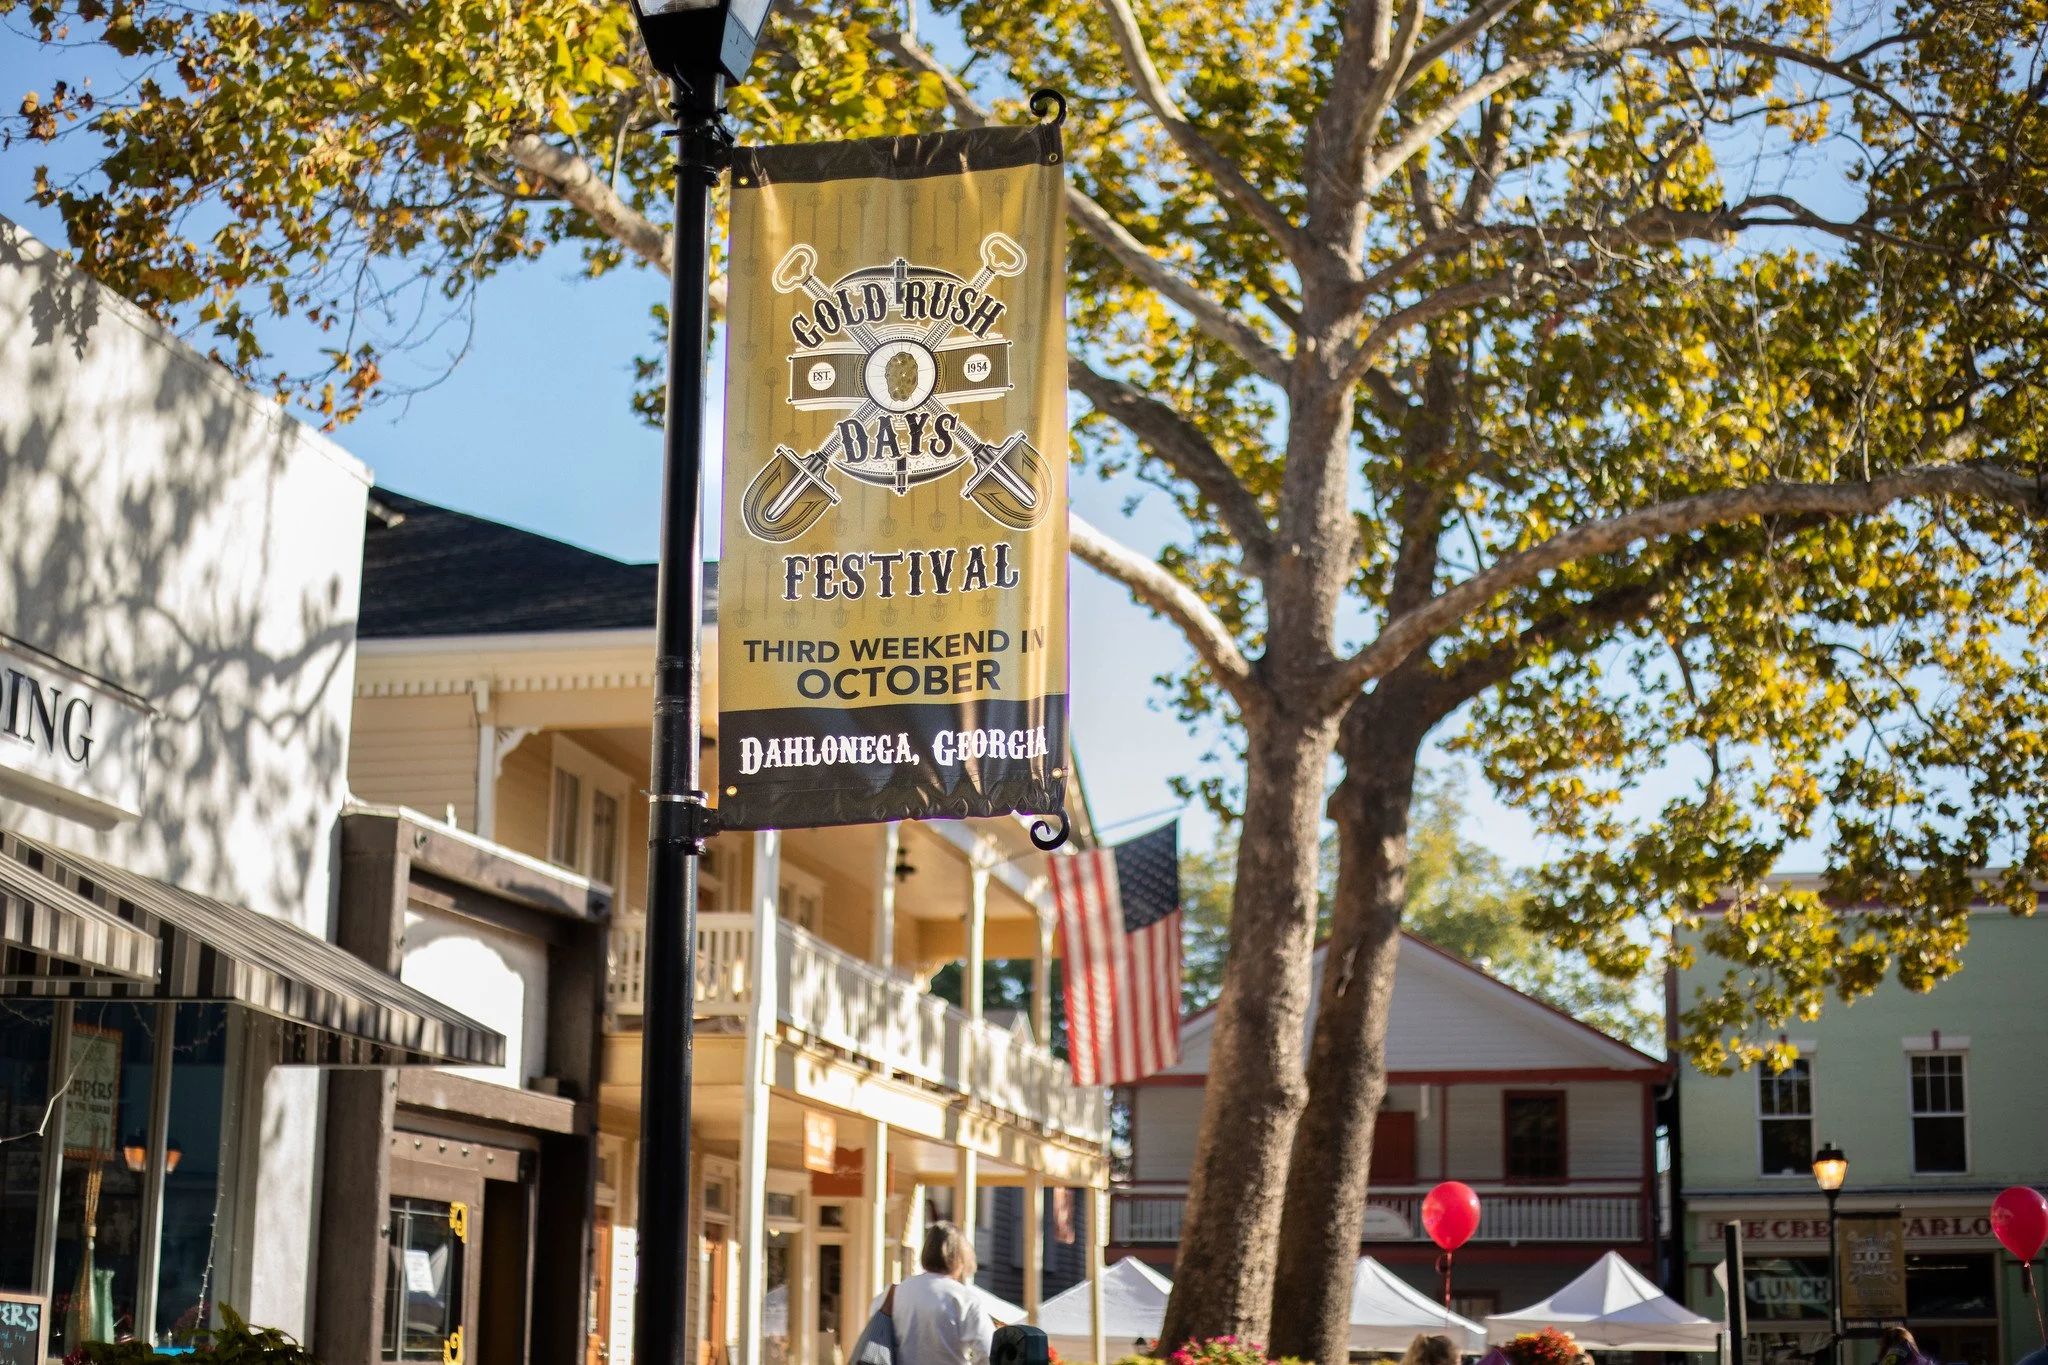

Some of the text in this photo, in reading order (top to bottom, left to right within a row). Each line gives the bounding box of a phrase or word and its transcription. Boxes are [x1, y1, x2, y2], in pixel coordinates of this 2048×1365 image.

[791, 280, 1007, 349] GOLD RUSH
[812, 361, 988, 382] EST. 1954
[838, 412, 959, 464] DAYS
[783, 543, 1020, 601] FESTIVAL
[743, 626, 1044, 664] THIRD WEEKEND IN
[797, 659, 1001, 700] OCTOBER
[0, 668, 94, 769] ING
[1771, 1220, 1831, 1240] CRE
[1903, 1218, 1992, 1237] ARLO
[1755, 1280, 1828, 1300] LUNCH
[0, 1302, 39, 1332] ERS
